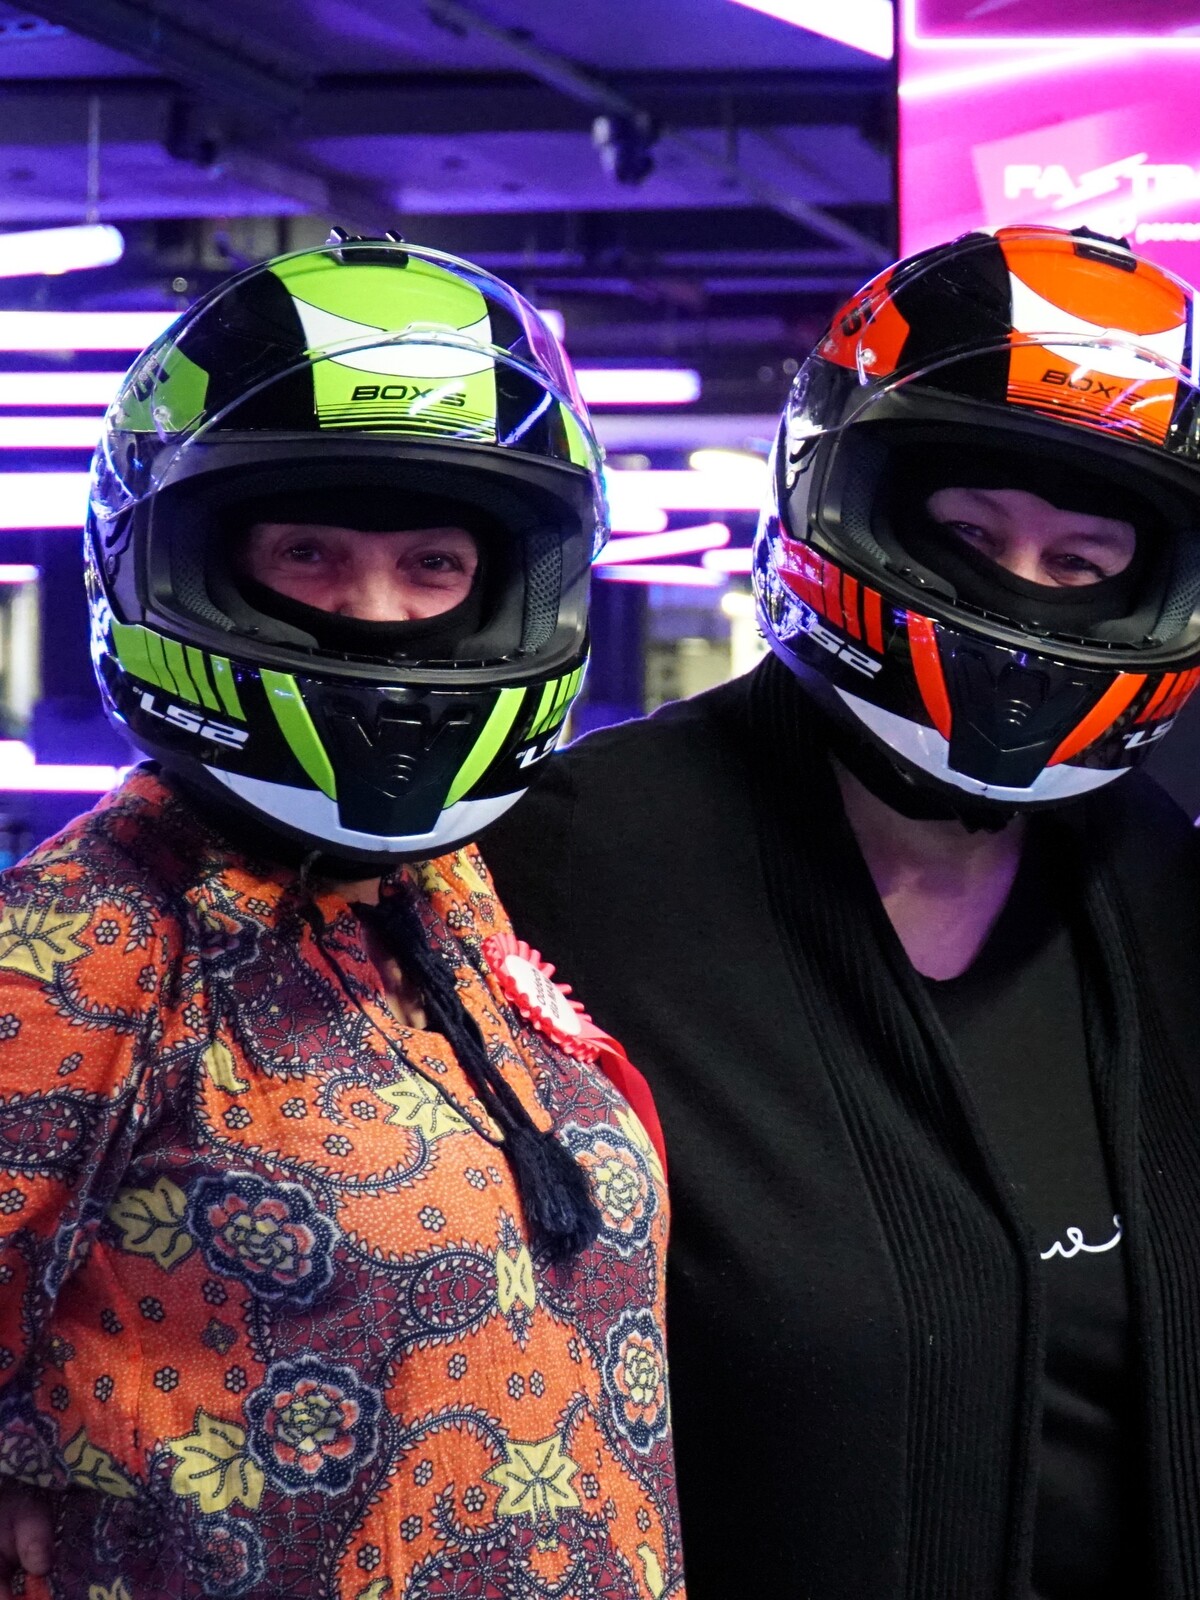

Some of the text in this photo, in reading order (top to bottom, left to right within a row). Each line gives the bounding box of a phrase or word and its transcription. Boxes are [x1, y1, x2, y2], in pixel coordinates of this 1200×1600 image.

[351, 385, 466, 407] BOXS
[140, 692, 250, 750] LS2
[520, 729, 560, 769] LS
